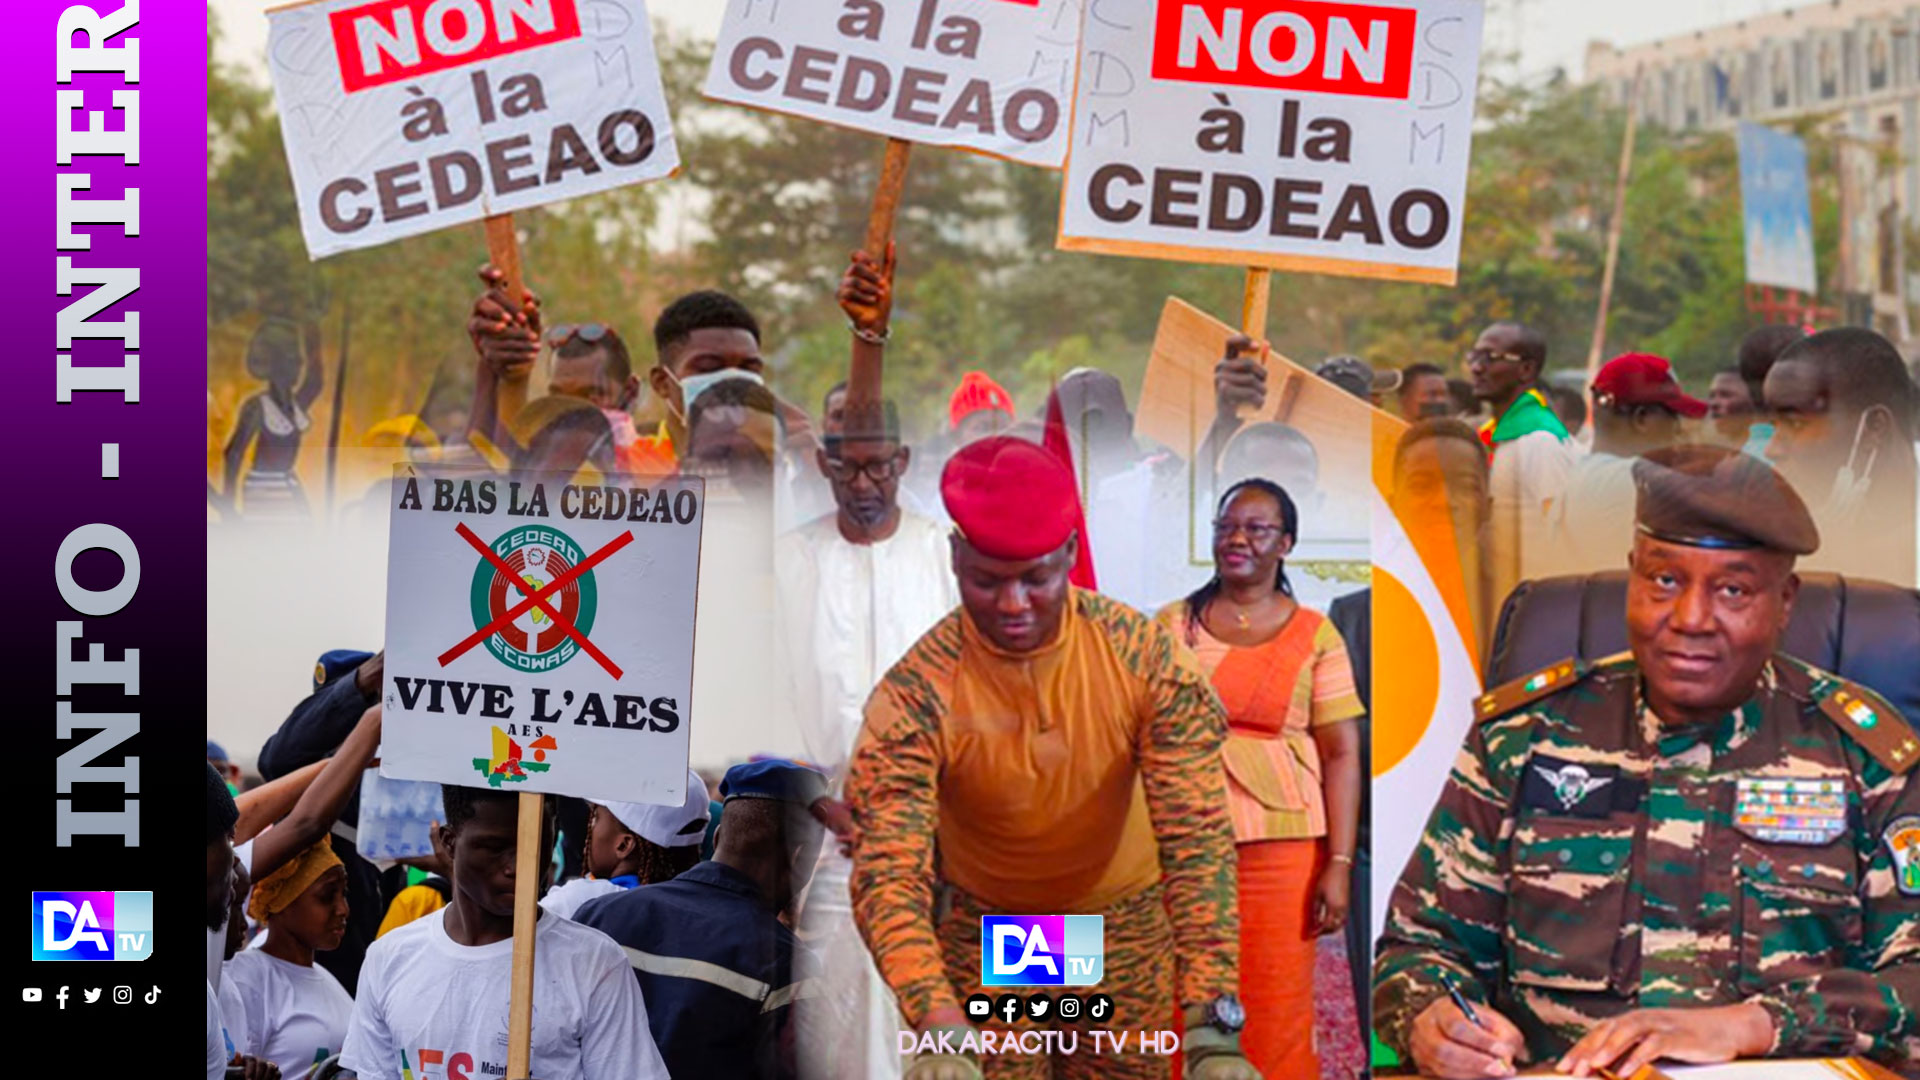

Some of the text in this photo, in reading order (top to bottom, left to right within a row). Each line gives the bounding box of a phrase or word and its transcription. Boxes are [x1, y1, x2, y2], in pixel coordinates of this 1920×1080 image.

[352, 0, 555, 77] NON
[910, 0, 983, 60] la
[1176, 4, 1390, 84] NON
[399, 69, 547, 143] à la
[729, 37, 1060, 143] CEDEAO
[1195, 92, 1352, 164] à la
[318, 109, 656, 234] CEDEAO
[1088, 163, 1450, 249] CEDEAO
[399, 466, 698, 526] À BAS LA CEDEAO
[496, 530, 579, 565] CEDEAO
[491, 632, 575, 670] ECOWAS
[394, 676, 680, 734] VIVE L'AES
[507, 723, 544, 738] AES
